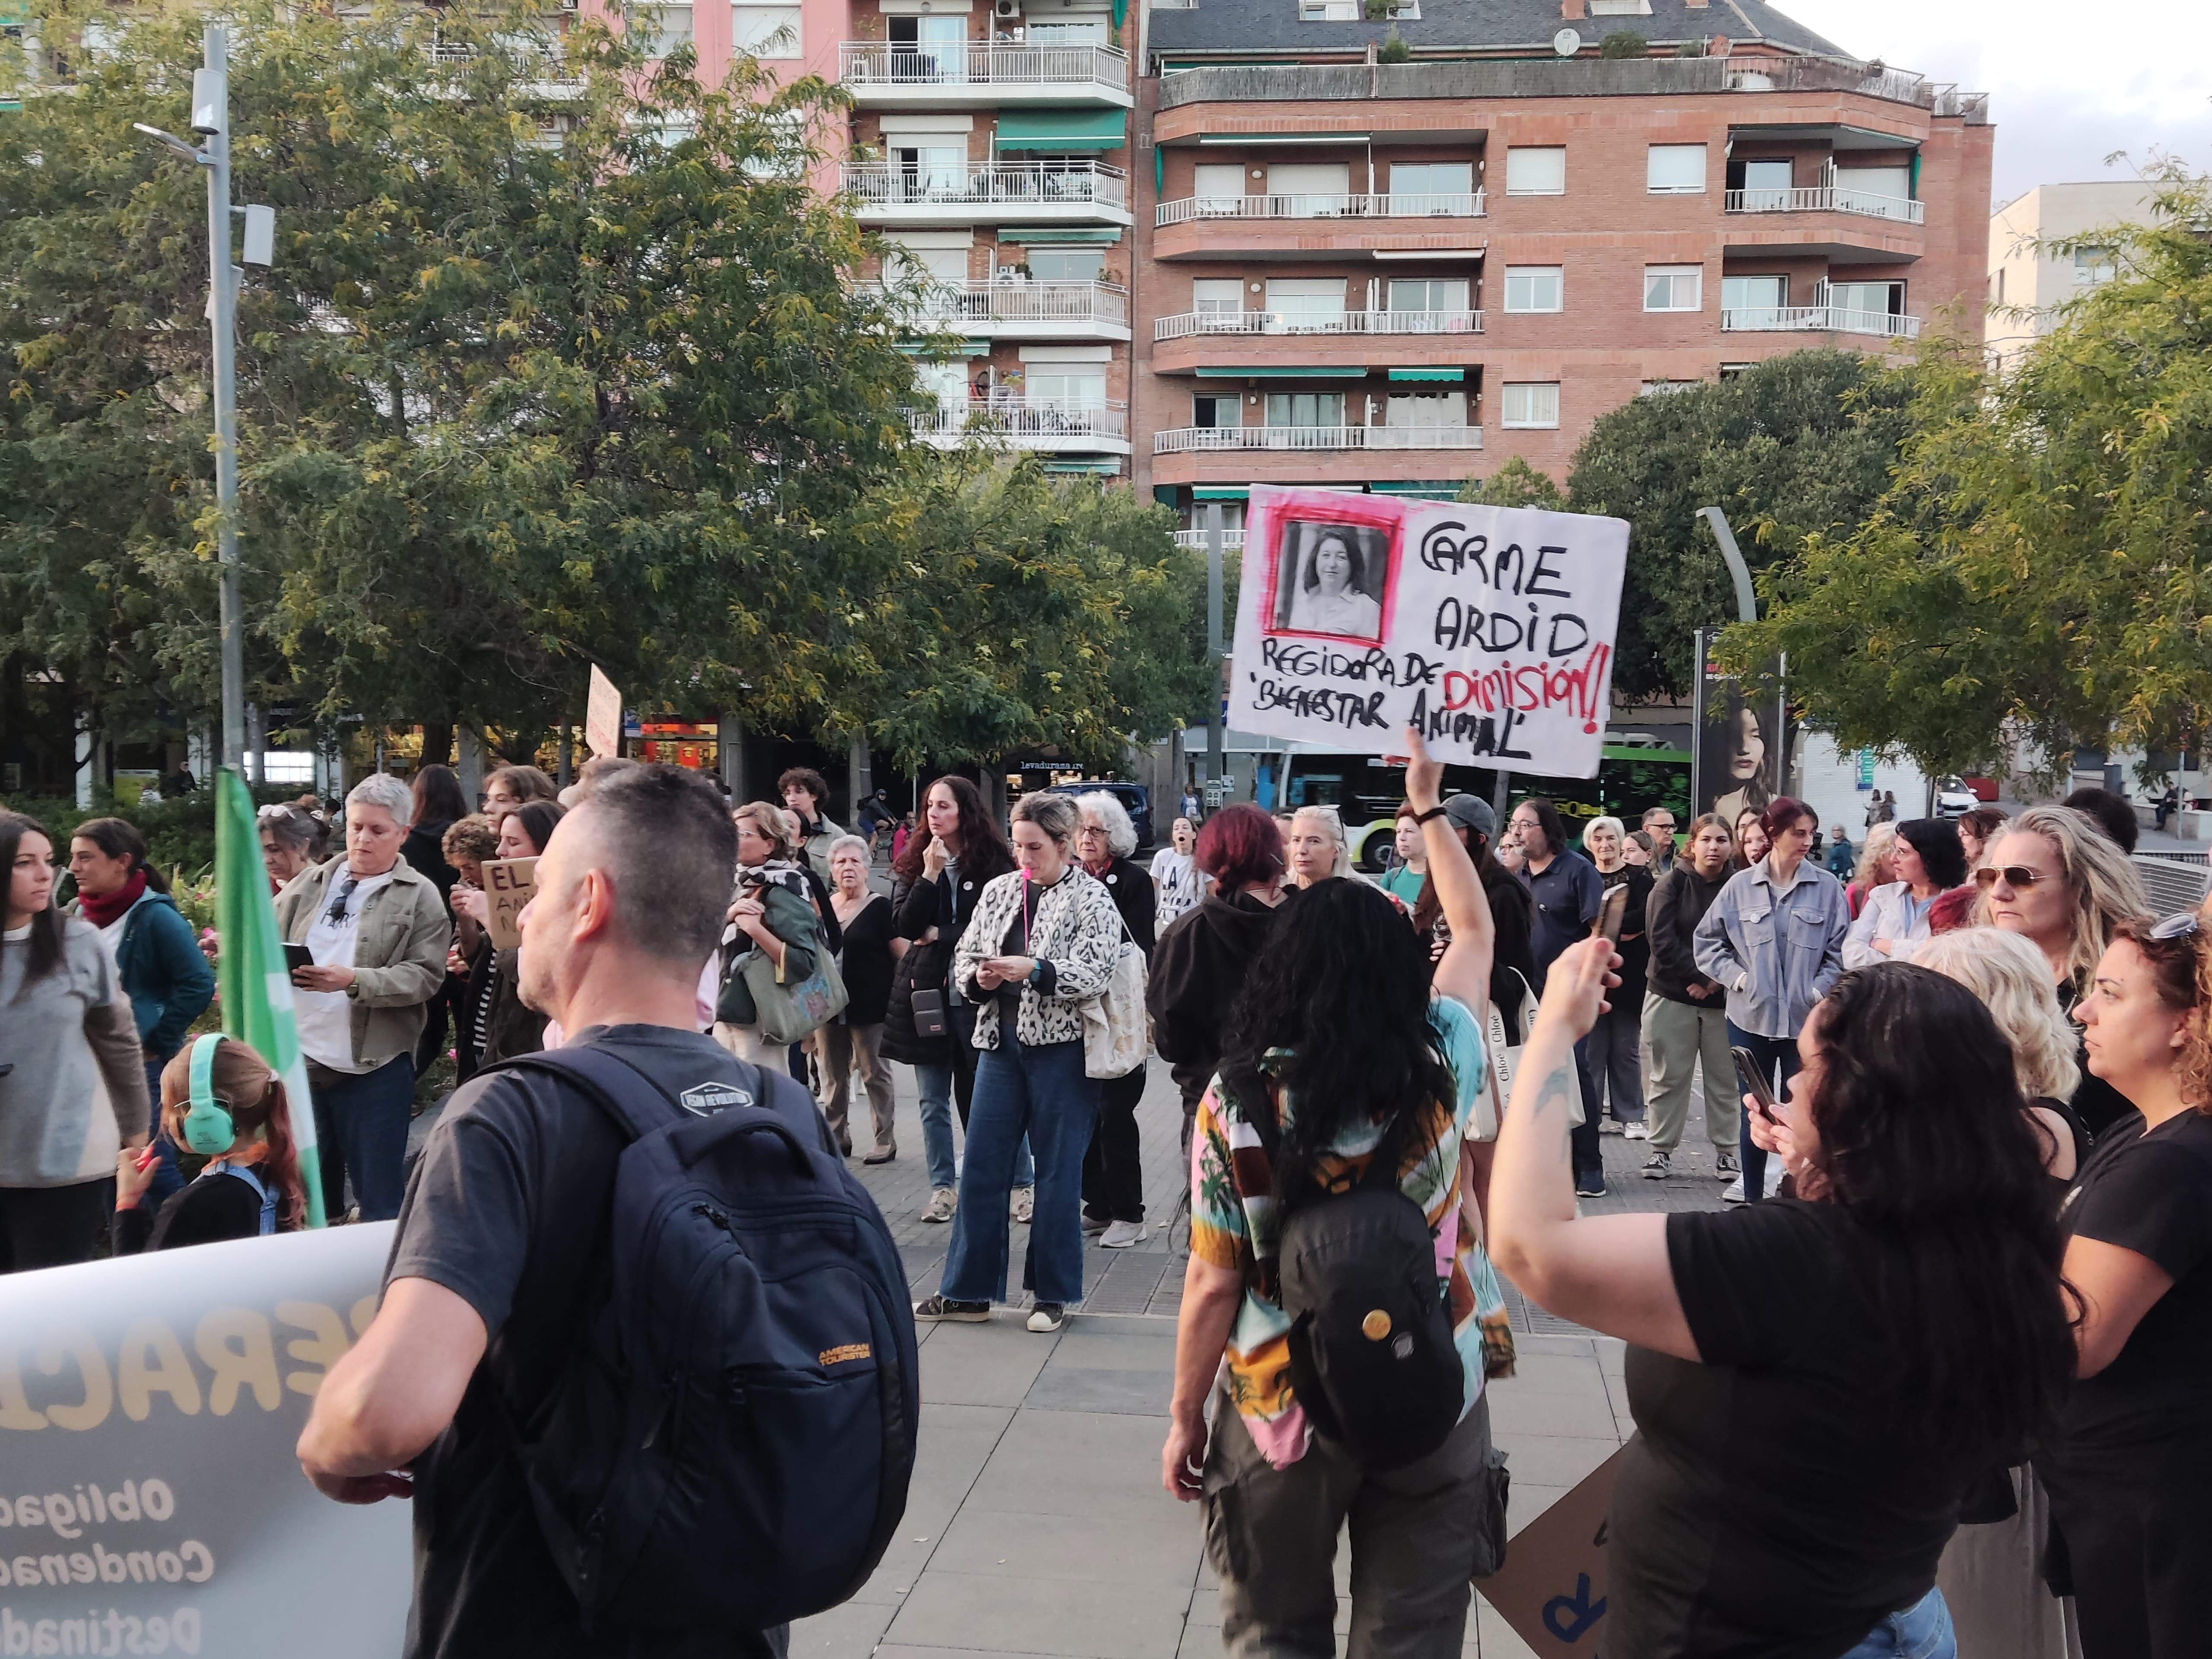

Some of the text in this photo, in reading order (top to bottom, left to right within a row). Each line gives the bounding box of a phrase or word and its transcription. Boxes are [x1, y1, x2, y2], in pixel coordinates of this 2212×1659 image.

[1421, 521, 1570, 597] CARME
[1395, 652, 1444, 686] DE
[491, 866, 529, 890] EL
[1491, 1015, 1502, 1042] Chloé
[1496, 1053, 1510, 1081] Chloé
[819, 1343, 869, 1360] AMERICAN
[819, 1351, 870, 1366] TOURISTER
